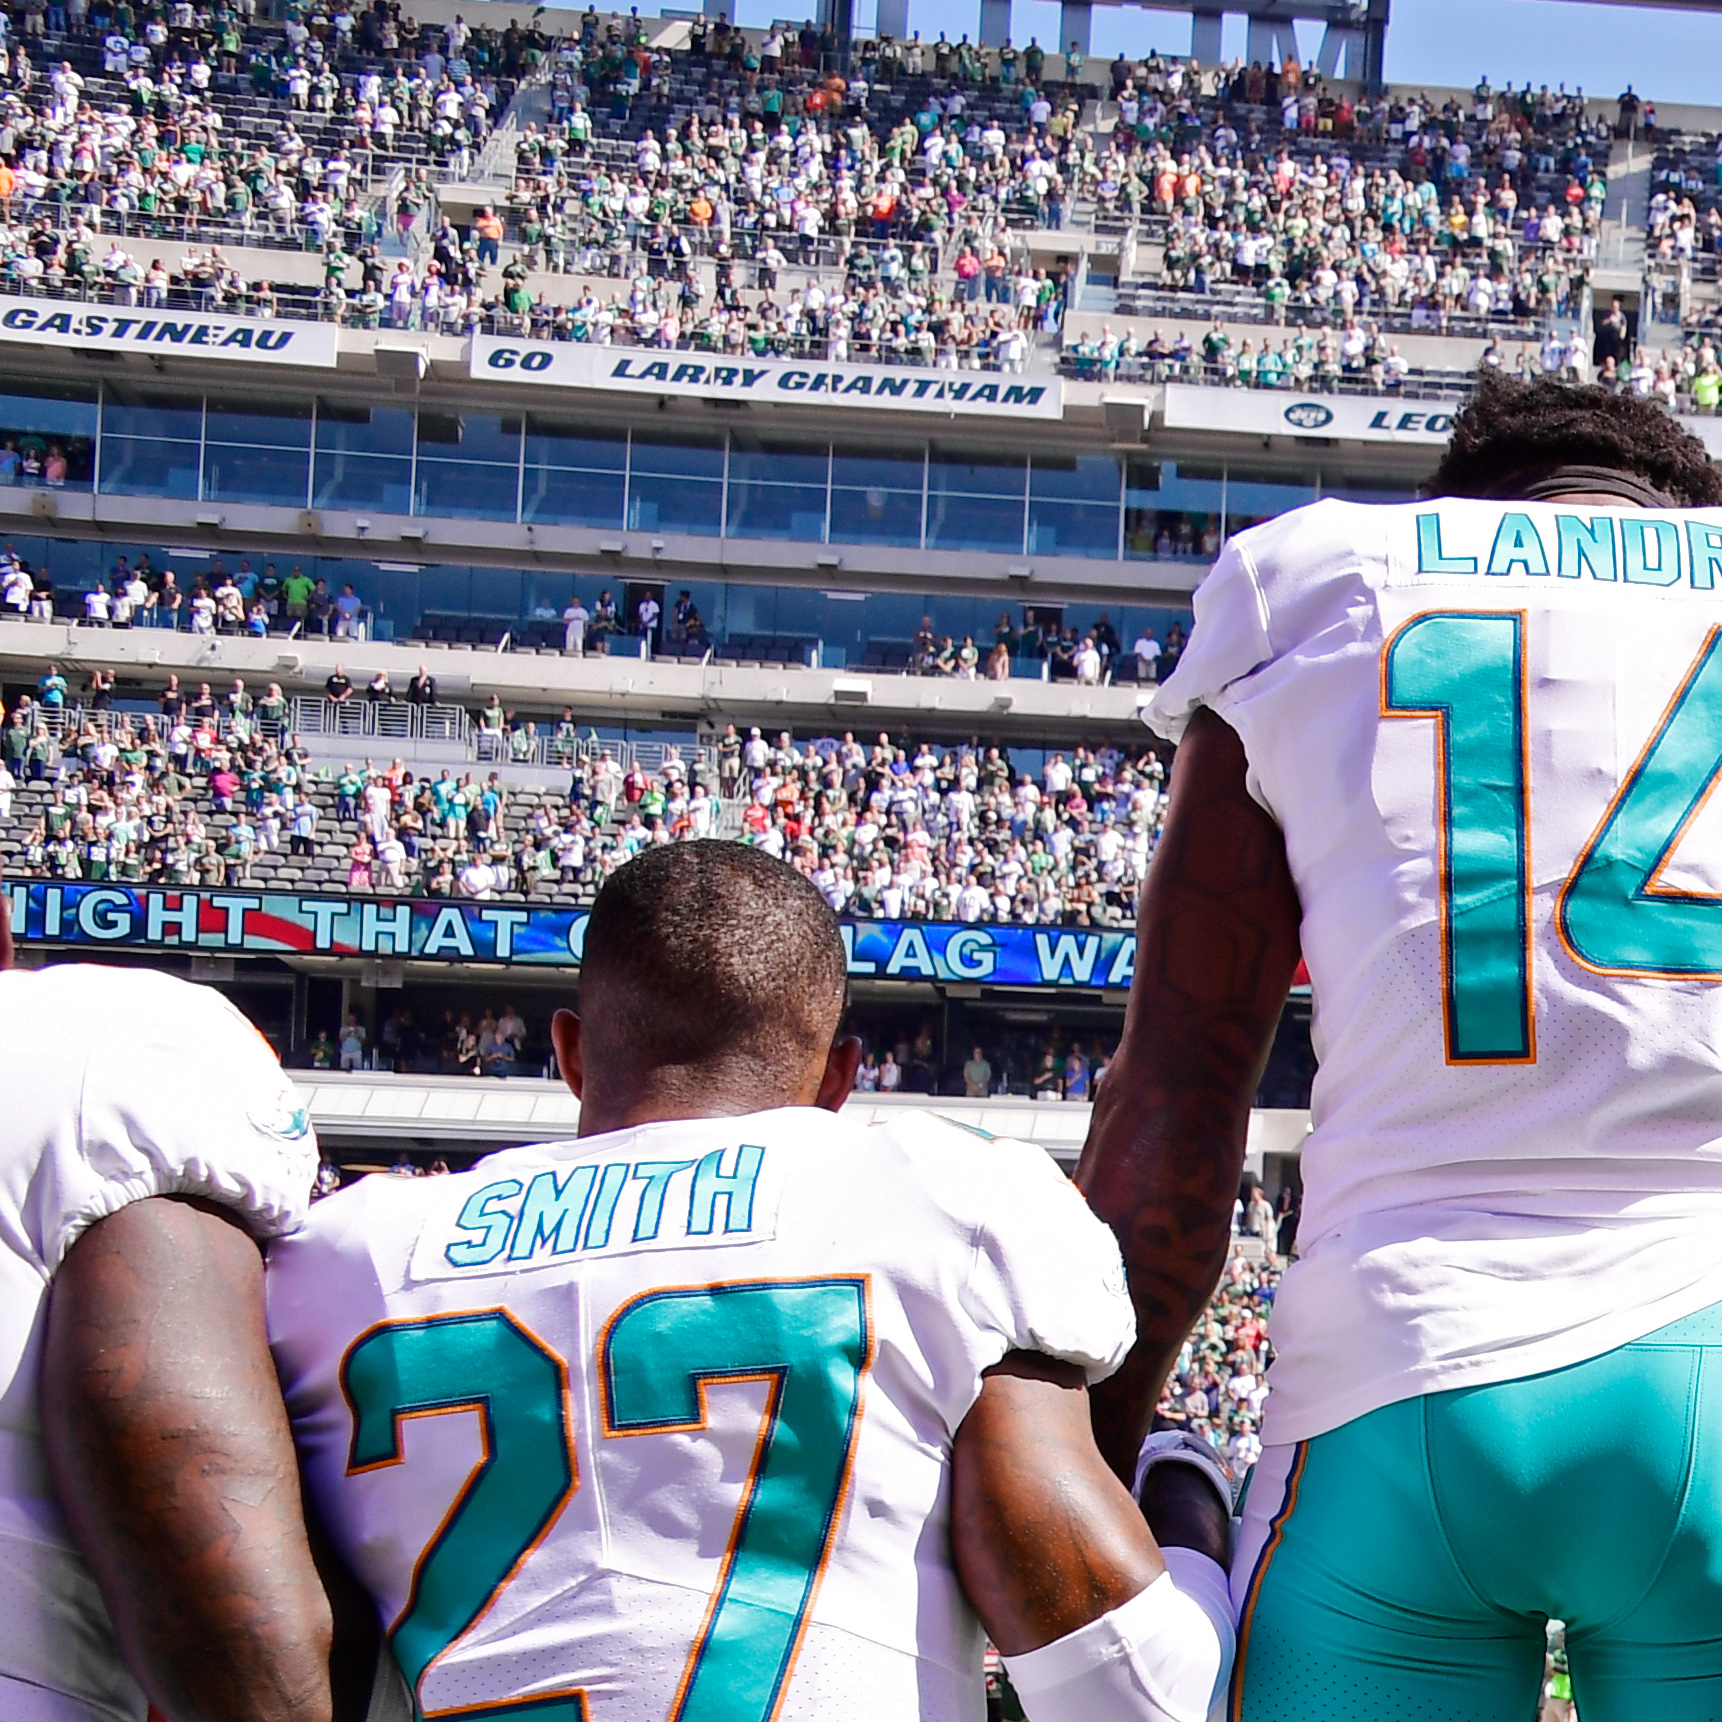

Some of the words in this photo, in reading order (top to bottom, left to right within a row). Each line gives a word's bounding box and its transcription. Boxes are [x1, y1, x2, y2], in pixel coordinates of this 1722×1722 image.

[2, 308, 295, 351] GASTINEAU
[487, 349, 554, 372] 60
[611, 359, 771, 389] LARRY
[778, 370, 1046, 406] GRANTHAM
[1368, 411, 1453, 433] LEO
[301, 900, 529, 958] THAT
[840, 924, 996, 979] LAG
[1035, 932, 1137, 985] WA
[445, 1144, 765, 1268] SMITH
